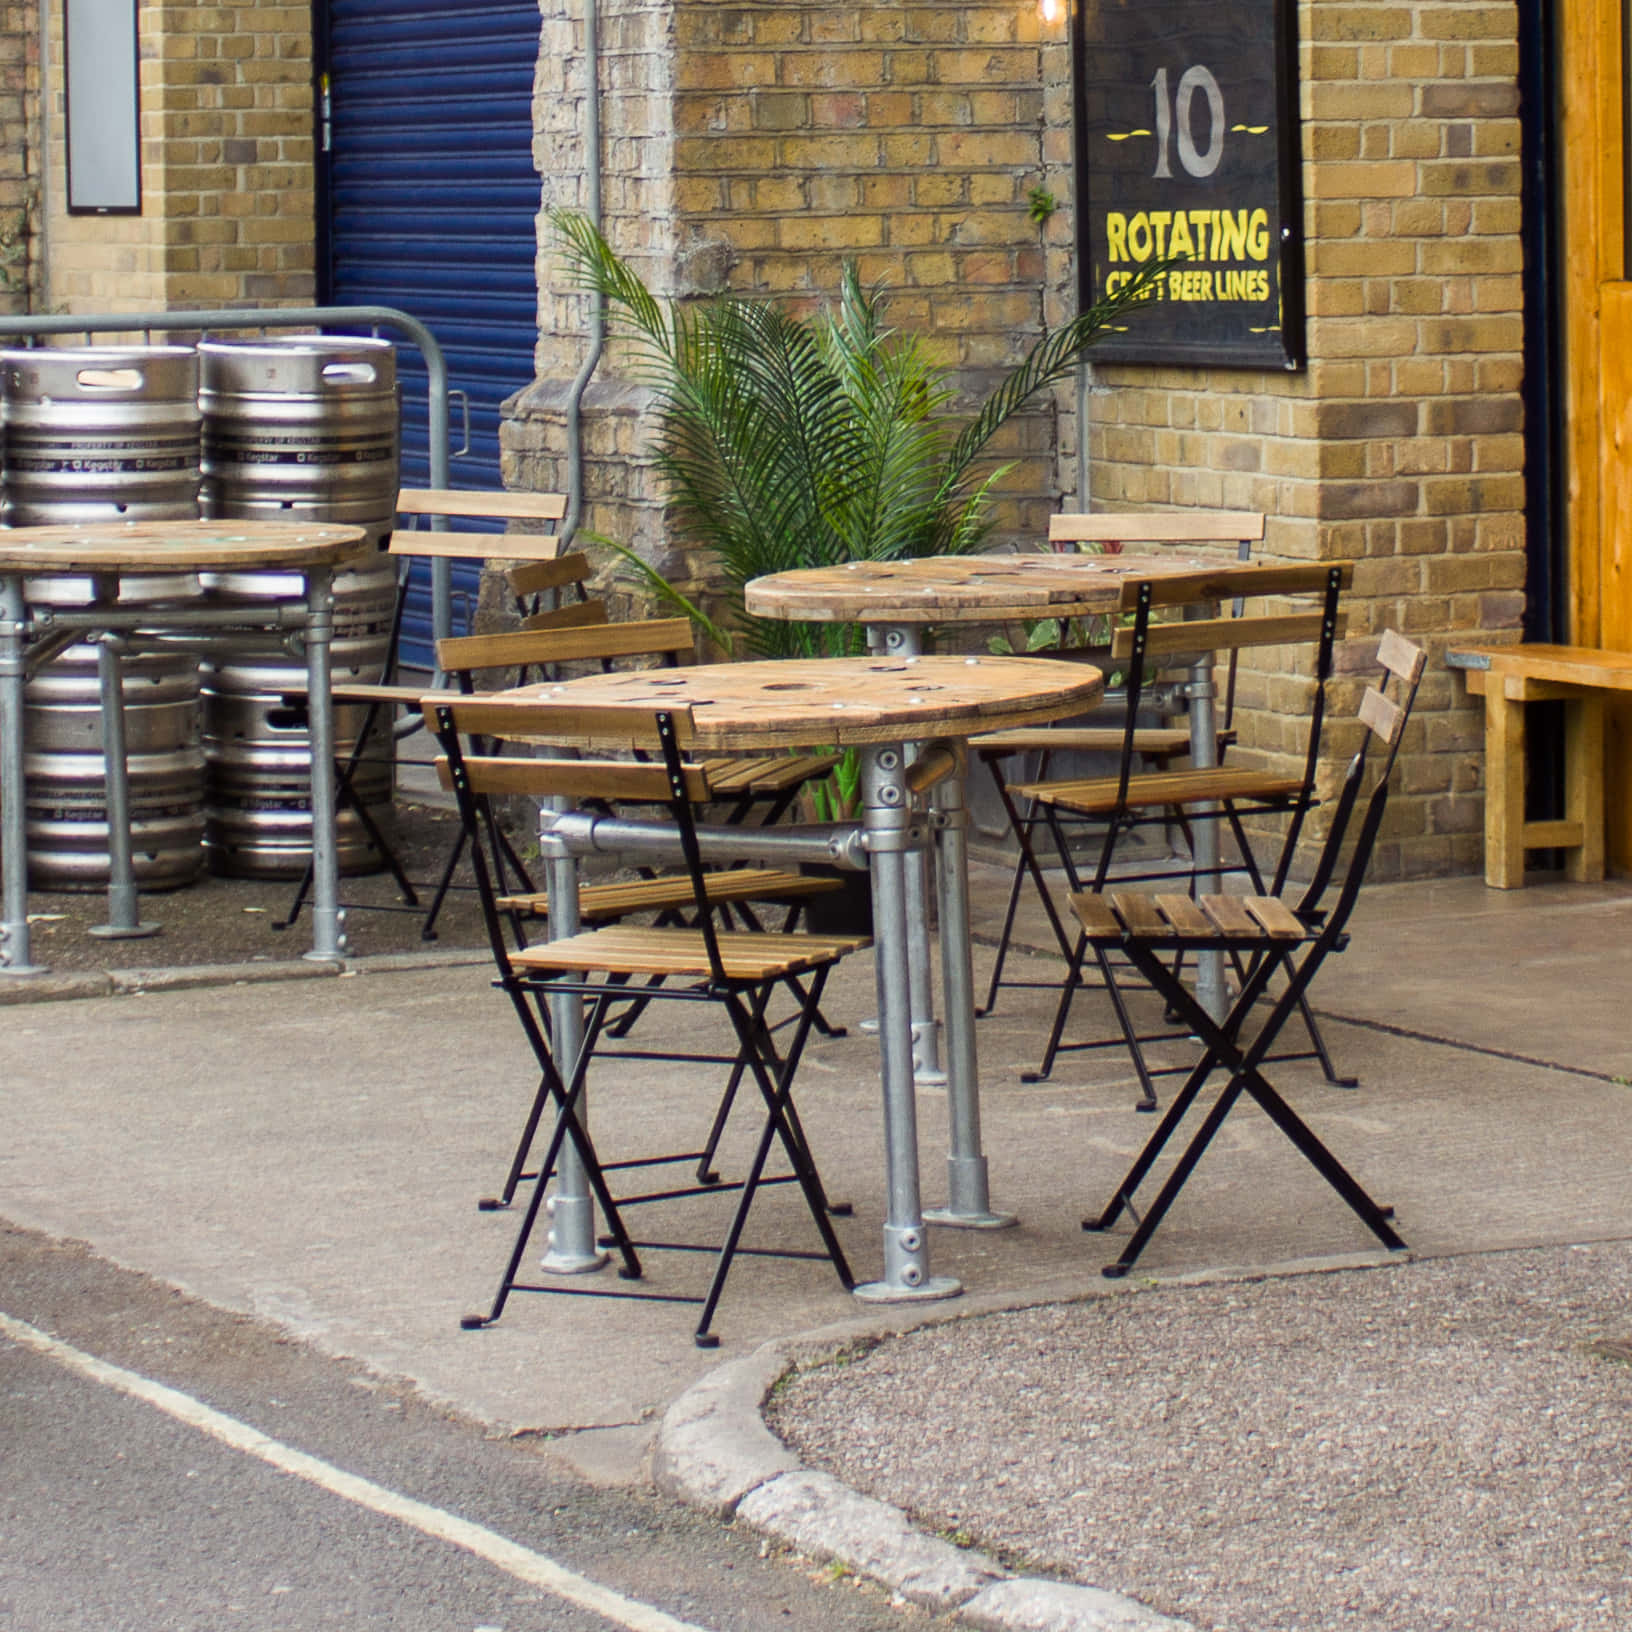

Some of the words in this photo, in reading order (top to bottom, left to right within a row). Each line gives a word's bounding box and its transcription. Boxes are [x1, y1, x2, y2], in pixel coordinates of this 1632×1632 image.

[1150, 65, 1225, 178] 10
[1106, 208, 1270, 262] ROTATING
[1169, 270, 1214, 301] BEER
[1215, 270, 1270, 302] LINES
